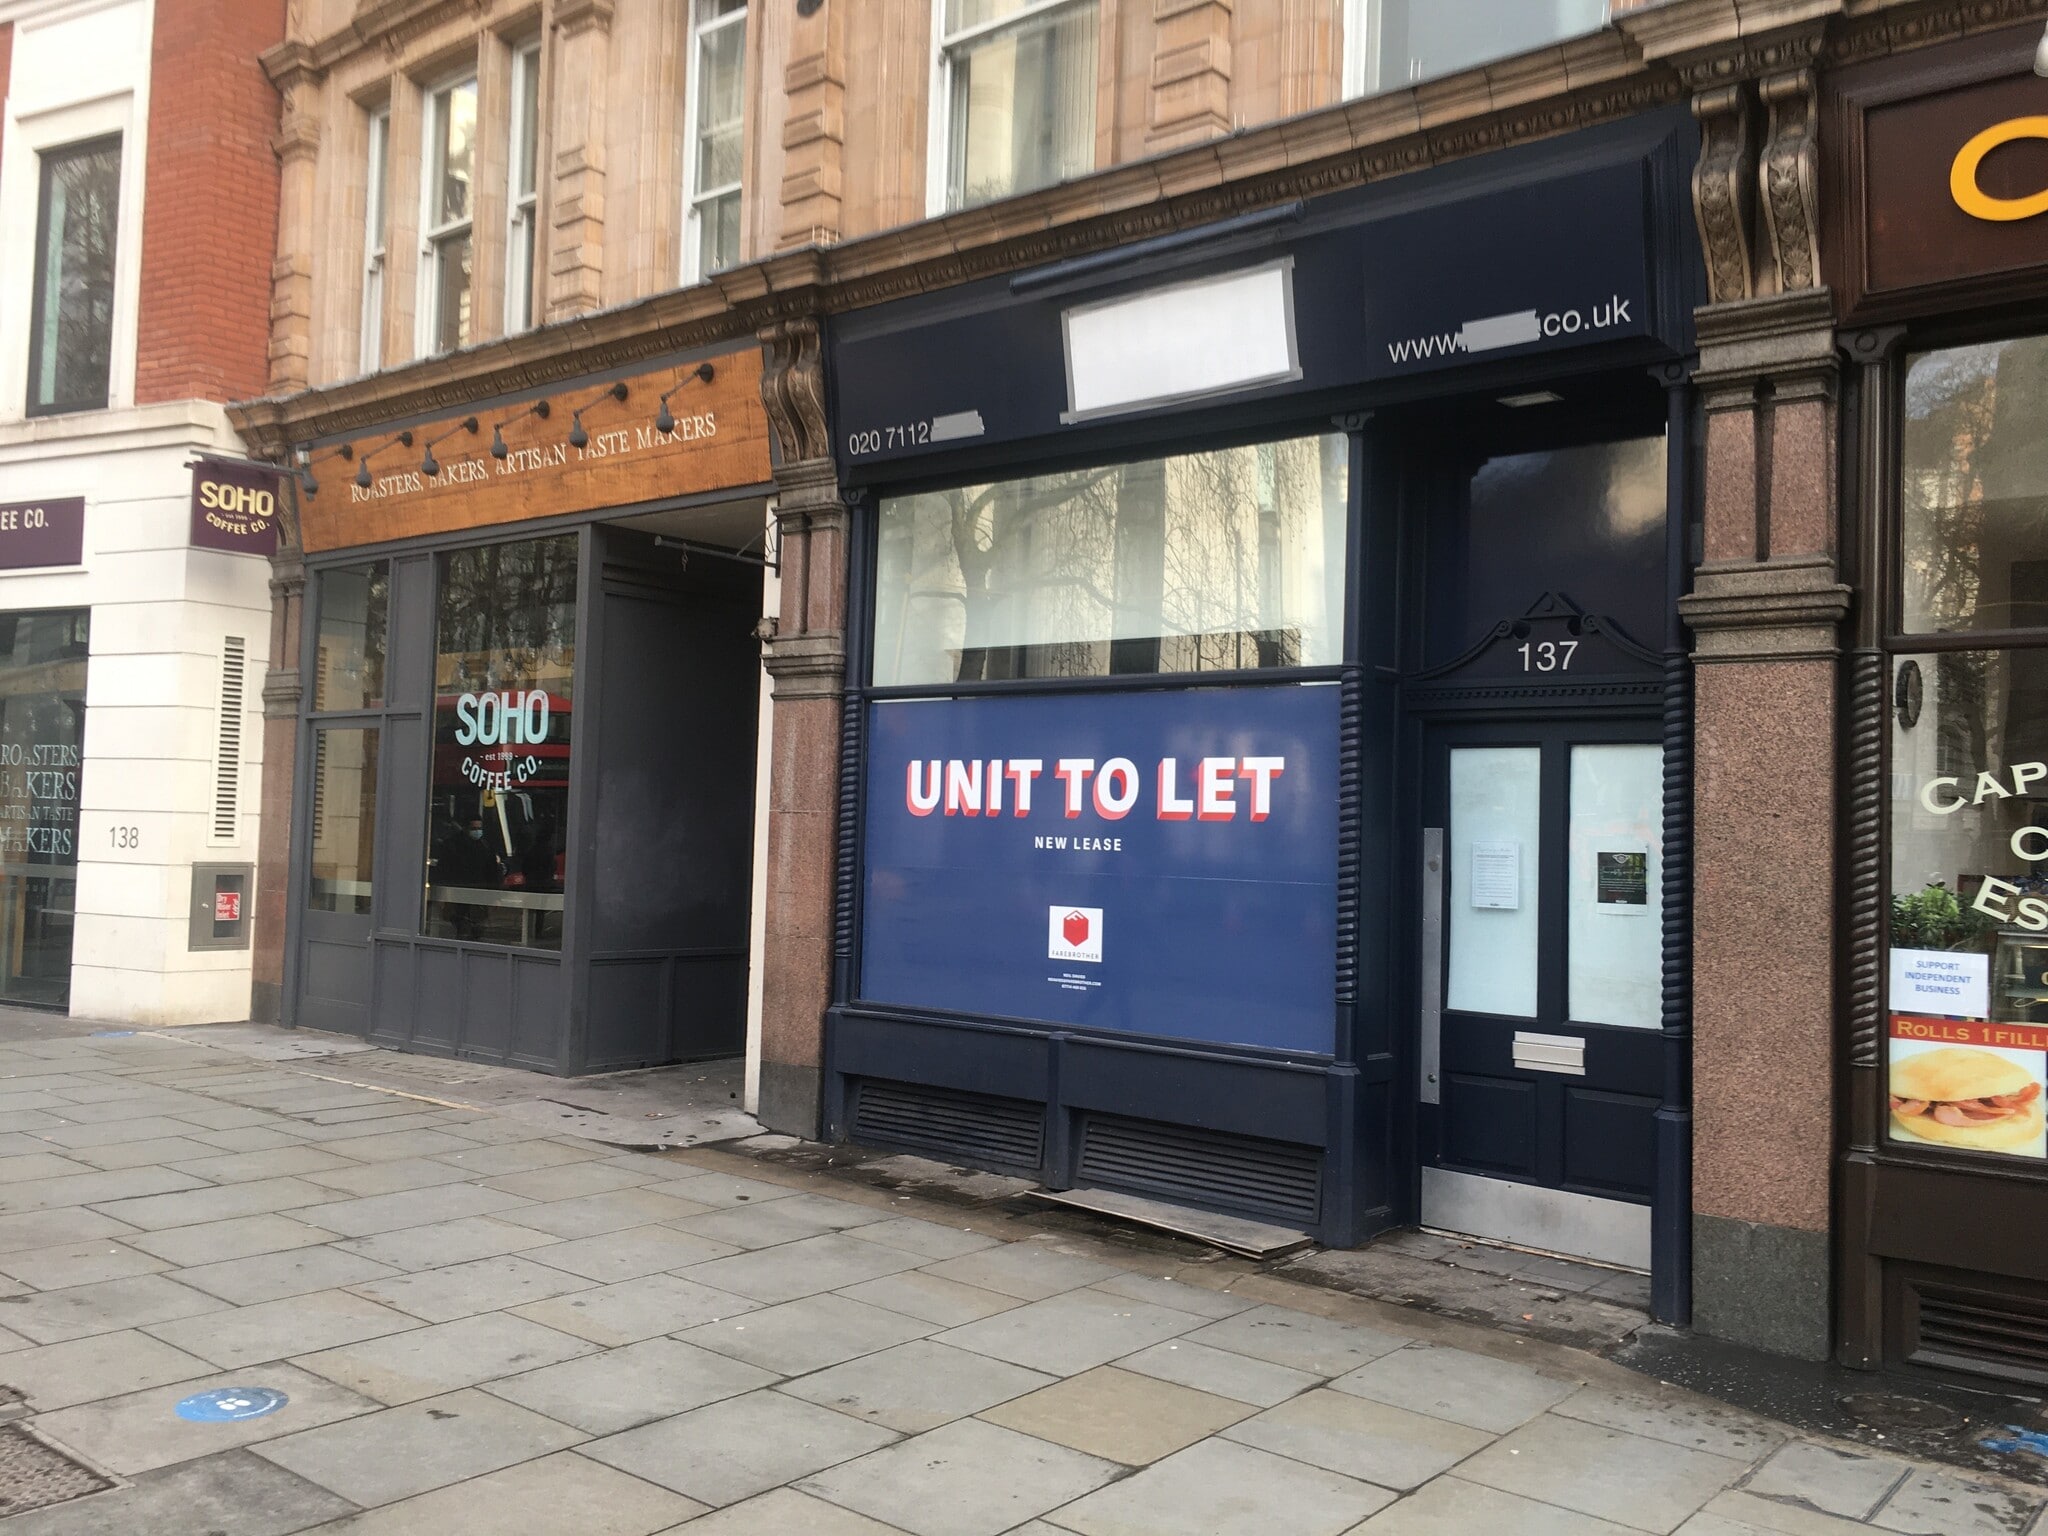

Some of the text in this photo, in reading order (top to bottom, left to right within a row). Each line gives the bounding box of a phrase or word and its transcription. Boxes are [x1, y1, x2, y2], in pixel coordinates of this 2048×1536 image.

[849, 429, 881, 455] 020
[351, 471, 424, 503] ROASTERS,
[495, 443, 567, 475] ARTISAN
[636, 411, 717, 450] MAKERS
[200, 481, 274, 517] SOHO
[24, 508, 49, 528] CO.
[205, 512, 248, 535] COFFEE
[250, 518, 271, 533] CO.
[1517, 641, 1579, 672] 137
[455, 689, 549, 746] SOHO
[461, 755, 543, 791] COFFEE CO.
[906, 756, 1286, 823] UNIT TO LET
[109, 826, 140, 849] 138
[1034, 836, 1122, 852] NEW LEASE
[1915, 960, 1960, 971] SUPPORT
[1904, 971, 1972, 984] INDEPENDENT
[1915, 984, 1961, 995] BUSINESS
[1896, 1020, 1970, 1041] ROLLS
